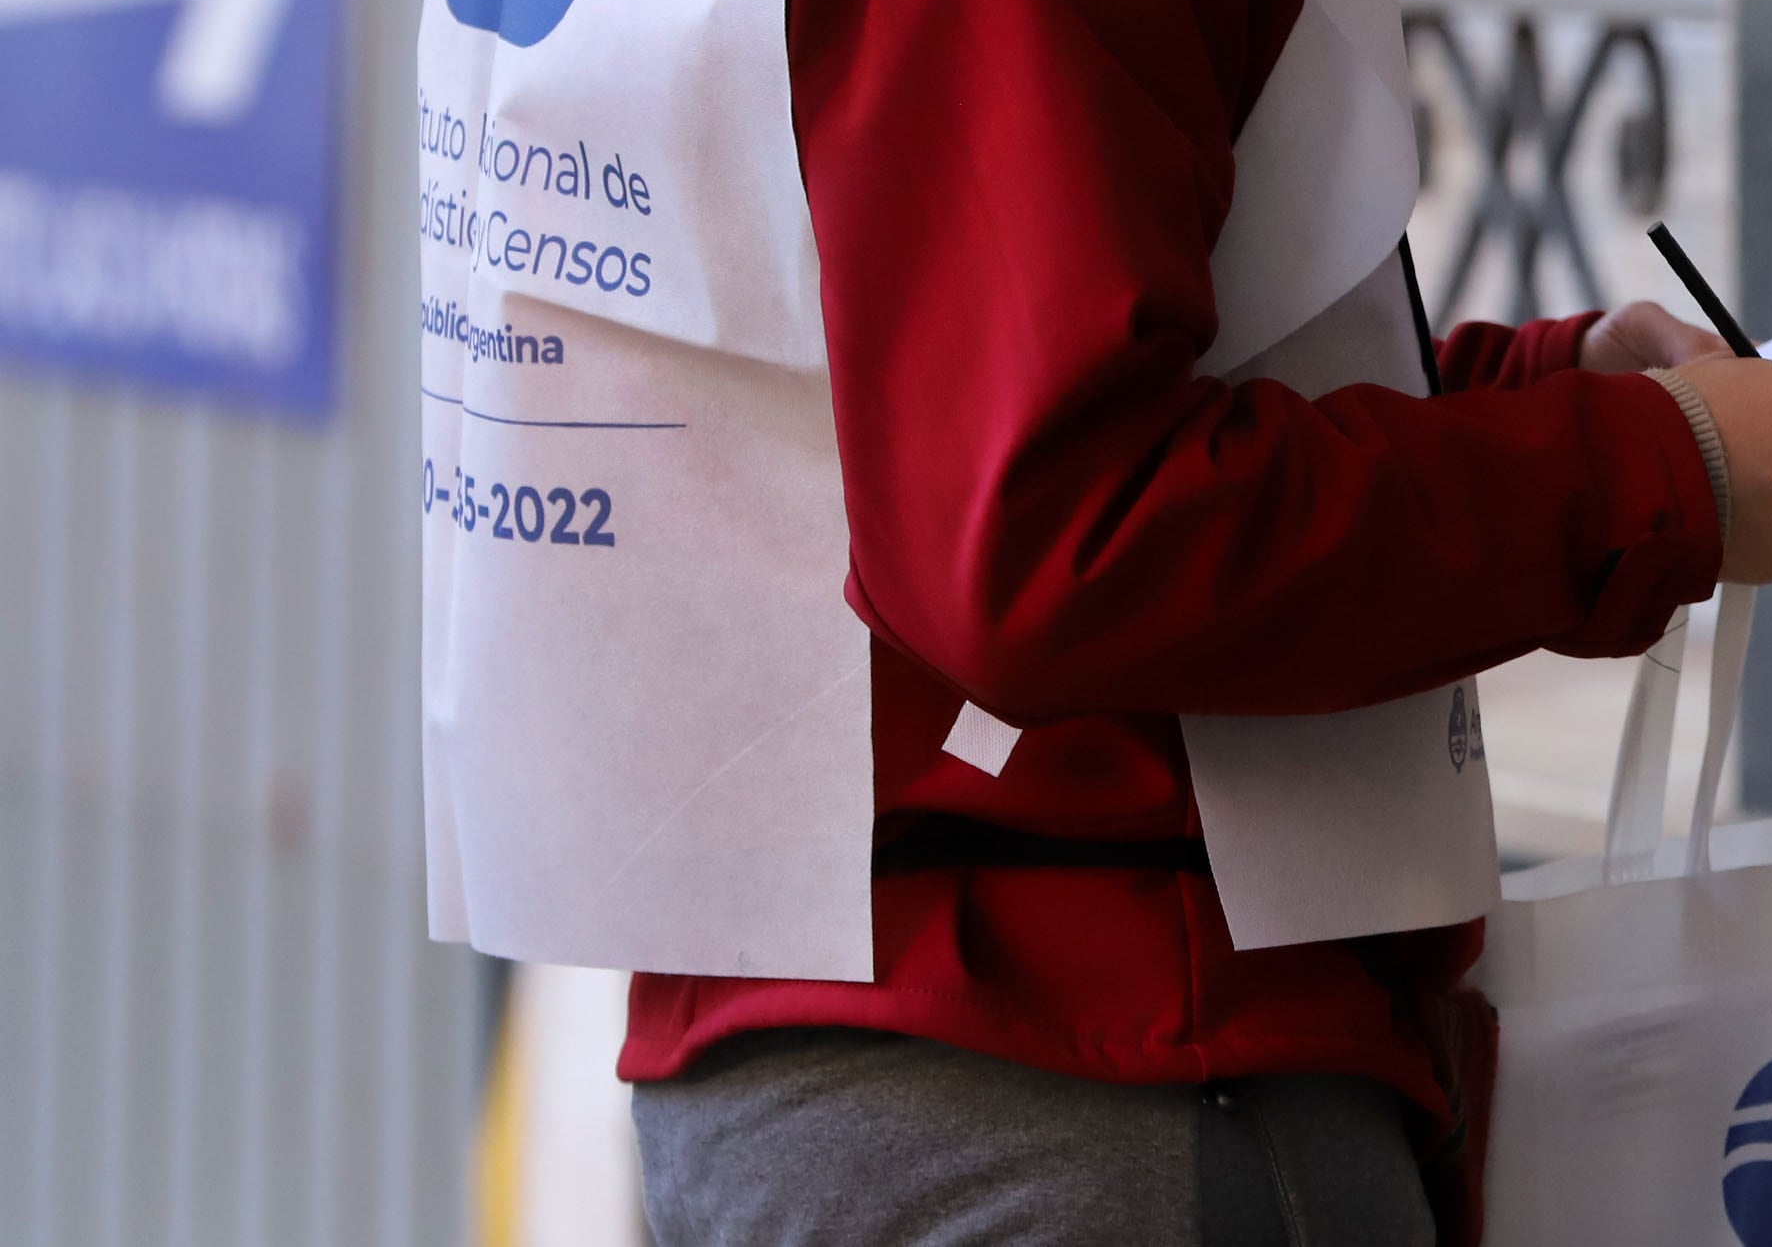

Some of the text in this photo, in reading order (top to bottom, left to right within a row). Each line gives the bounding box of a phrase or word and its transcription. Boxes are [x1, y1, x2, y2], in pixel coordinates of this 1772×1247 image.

[602, 152, 652, 217] de
[486, 210, 652, 297] Censos
[467, 323, 565, 365] rgentina
